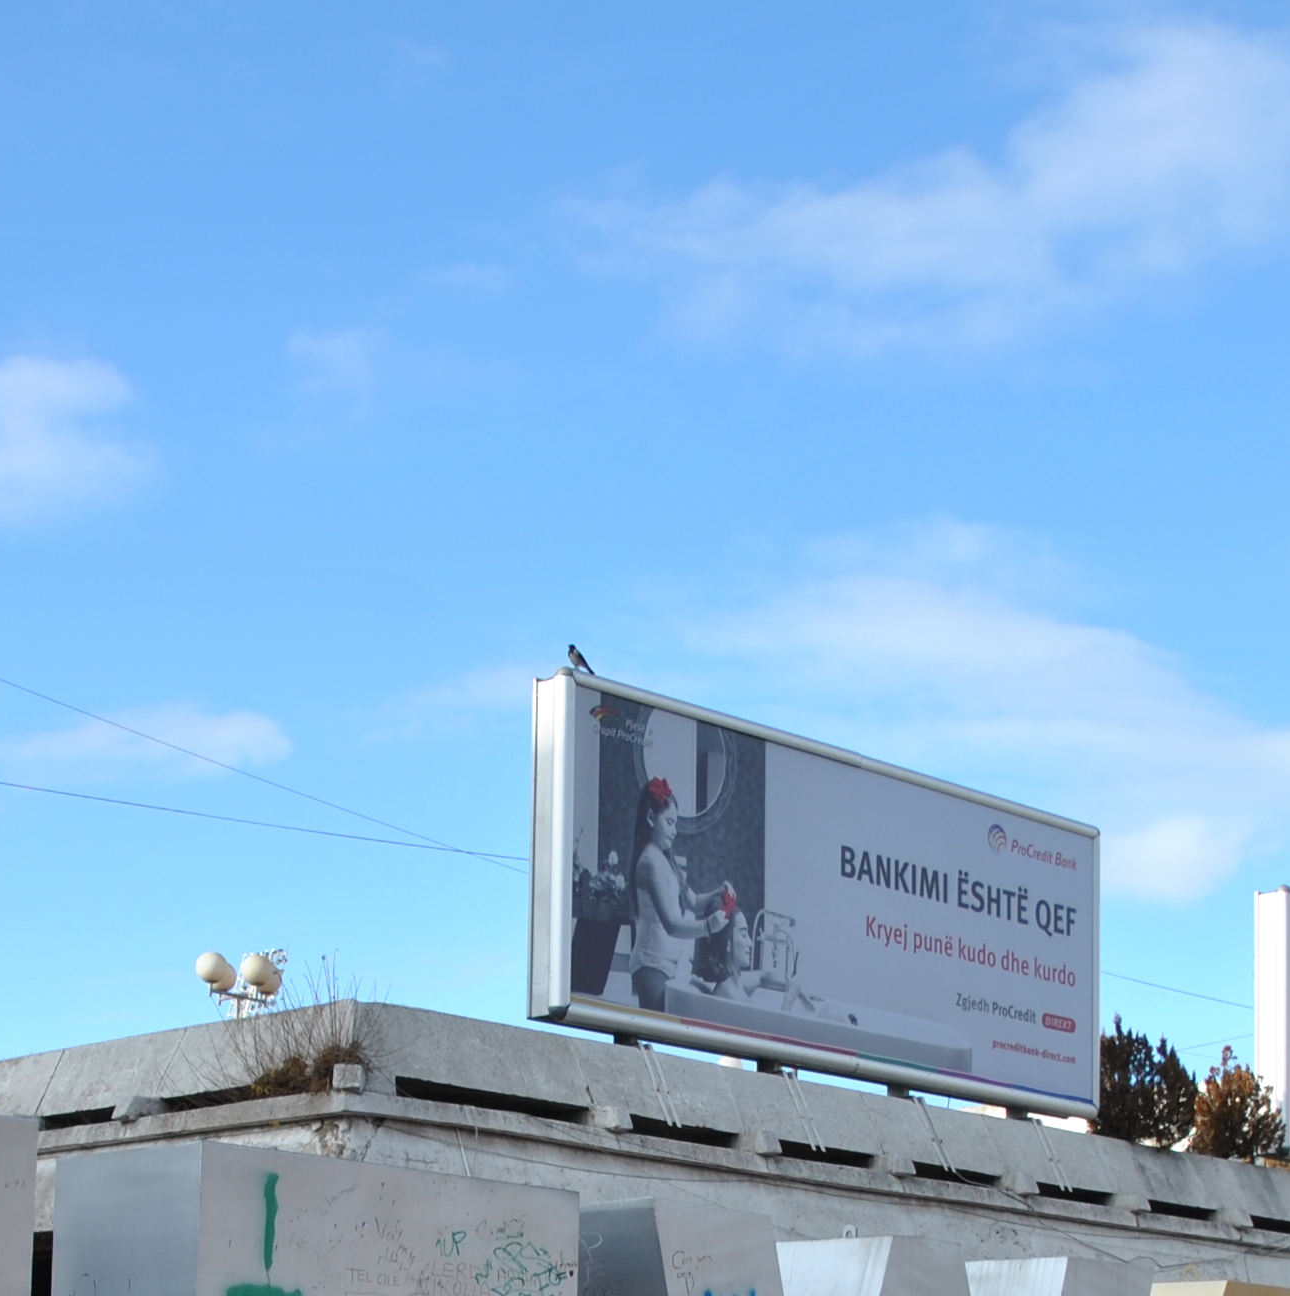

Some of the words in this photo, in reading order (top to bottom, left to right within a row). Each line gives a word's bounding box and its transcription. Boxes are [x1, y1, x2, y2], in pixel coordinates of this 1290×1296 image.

[1011, 838, 1053, 864] ProCredit
[1055, 852, 1077, 871] Bank
[840, 844, 948, 904] BANKIMI
[956, 870, 1029, 926] ËSHTË
[1035, 899, 1077, 937] QEF
[866, 914, 908, 951] Kryej
[913, 931, 953, 958] punë
[958, 937, 997, 968] kudo
[1000, 950, 1029, 976] dhe
[1034, 957, 1077, 988] kurdo
[955, 992, 990, 1013] Zgjedh
[992, 1002, 1037, 1024] ProCredit
[1044, 1016, 1073, 1031] DIREKT
